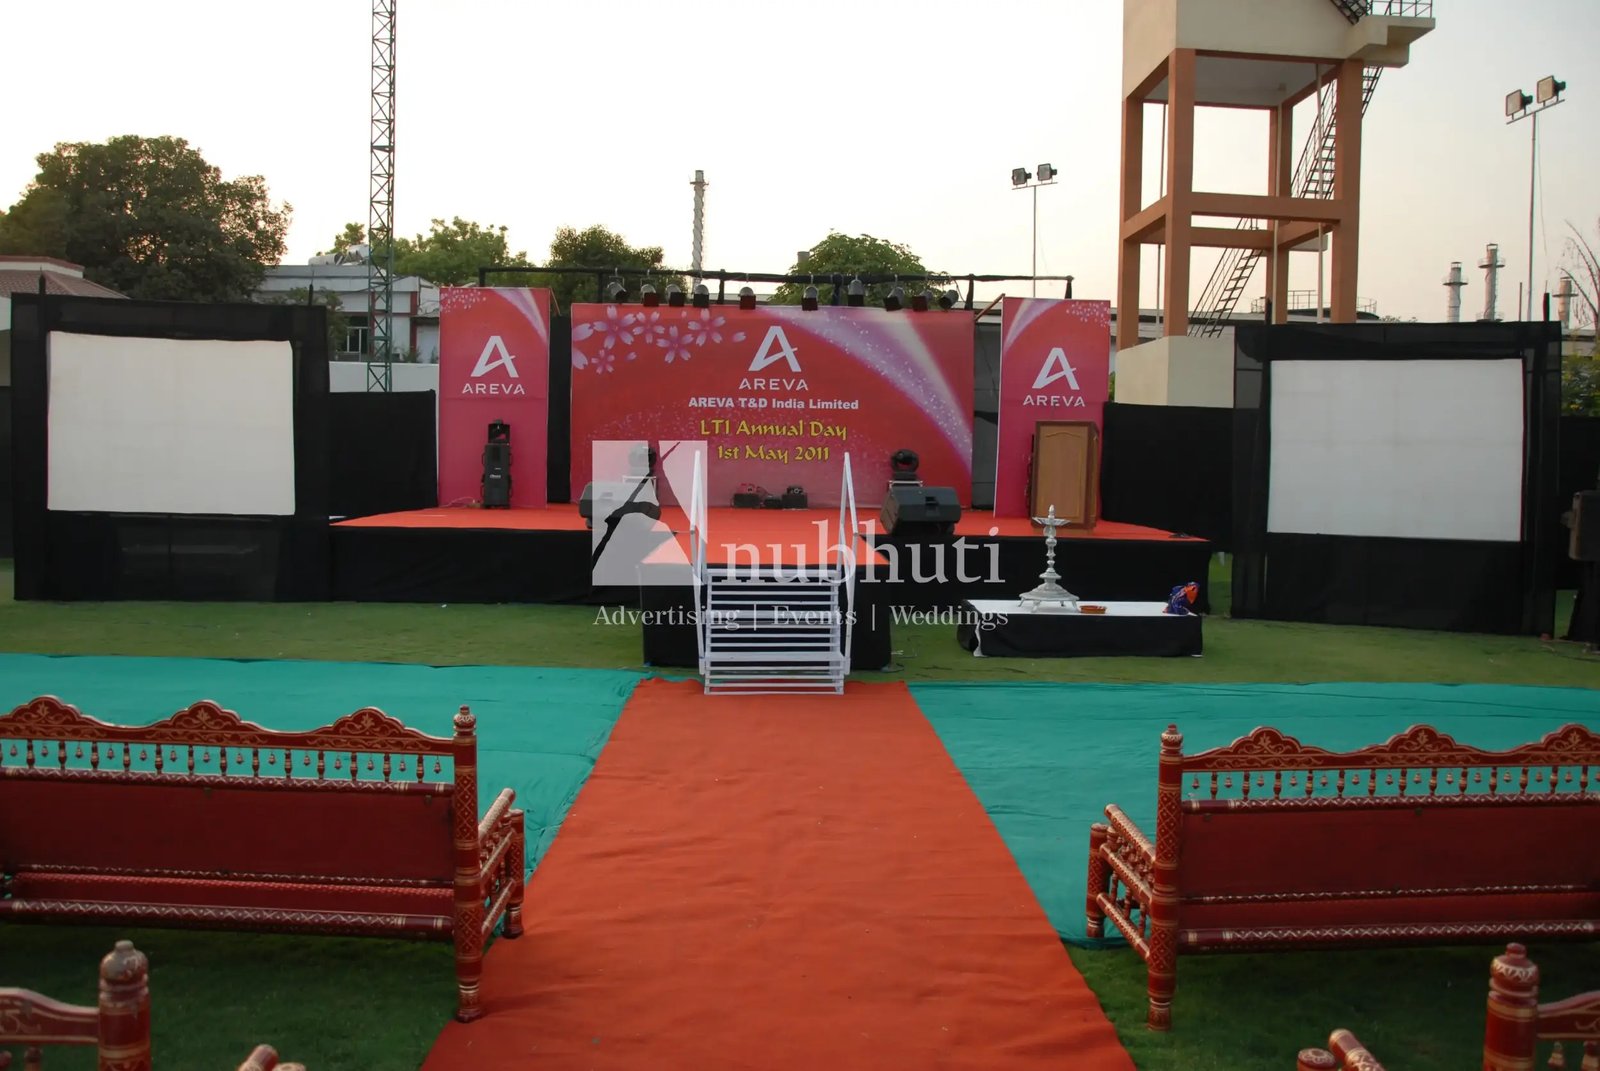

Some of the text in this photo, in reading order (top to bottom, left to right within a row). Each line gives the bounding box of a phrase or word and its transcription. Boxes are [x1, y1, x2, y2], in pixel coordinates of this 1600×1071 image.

[462, 383, 526, 395] AREVA
[739, 378, 809, 391] AREVA
[688, 397, 859, 410] AREVA T&D India Limited
[1023, 394, 1086, 407] AREVA
[736, 419, 804, 437] Annual
[809, 421, 848, 441] Day
[718, 445, 830, 464] 1st May 2011
